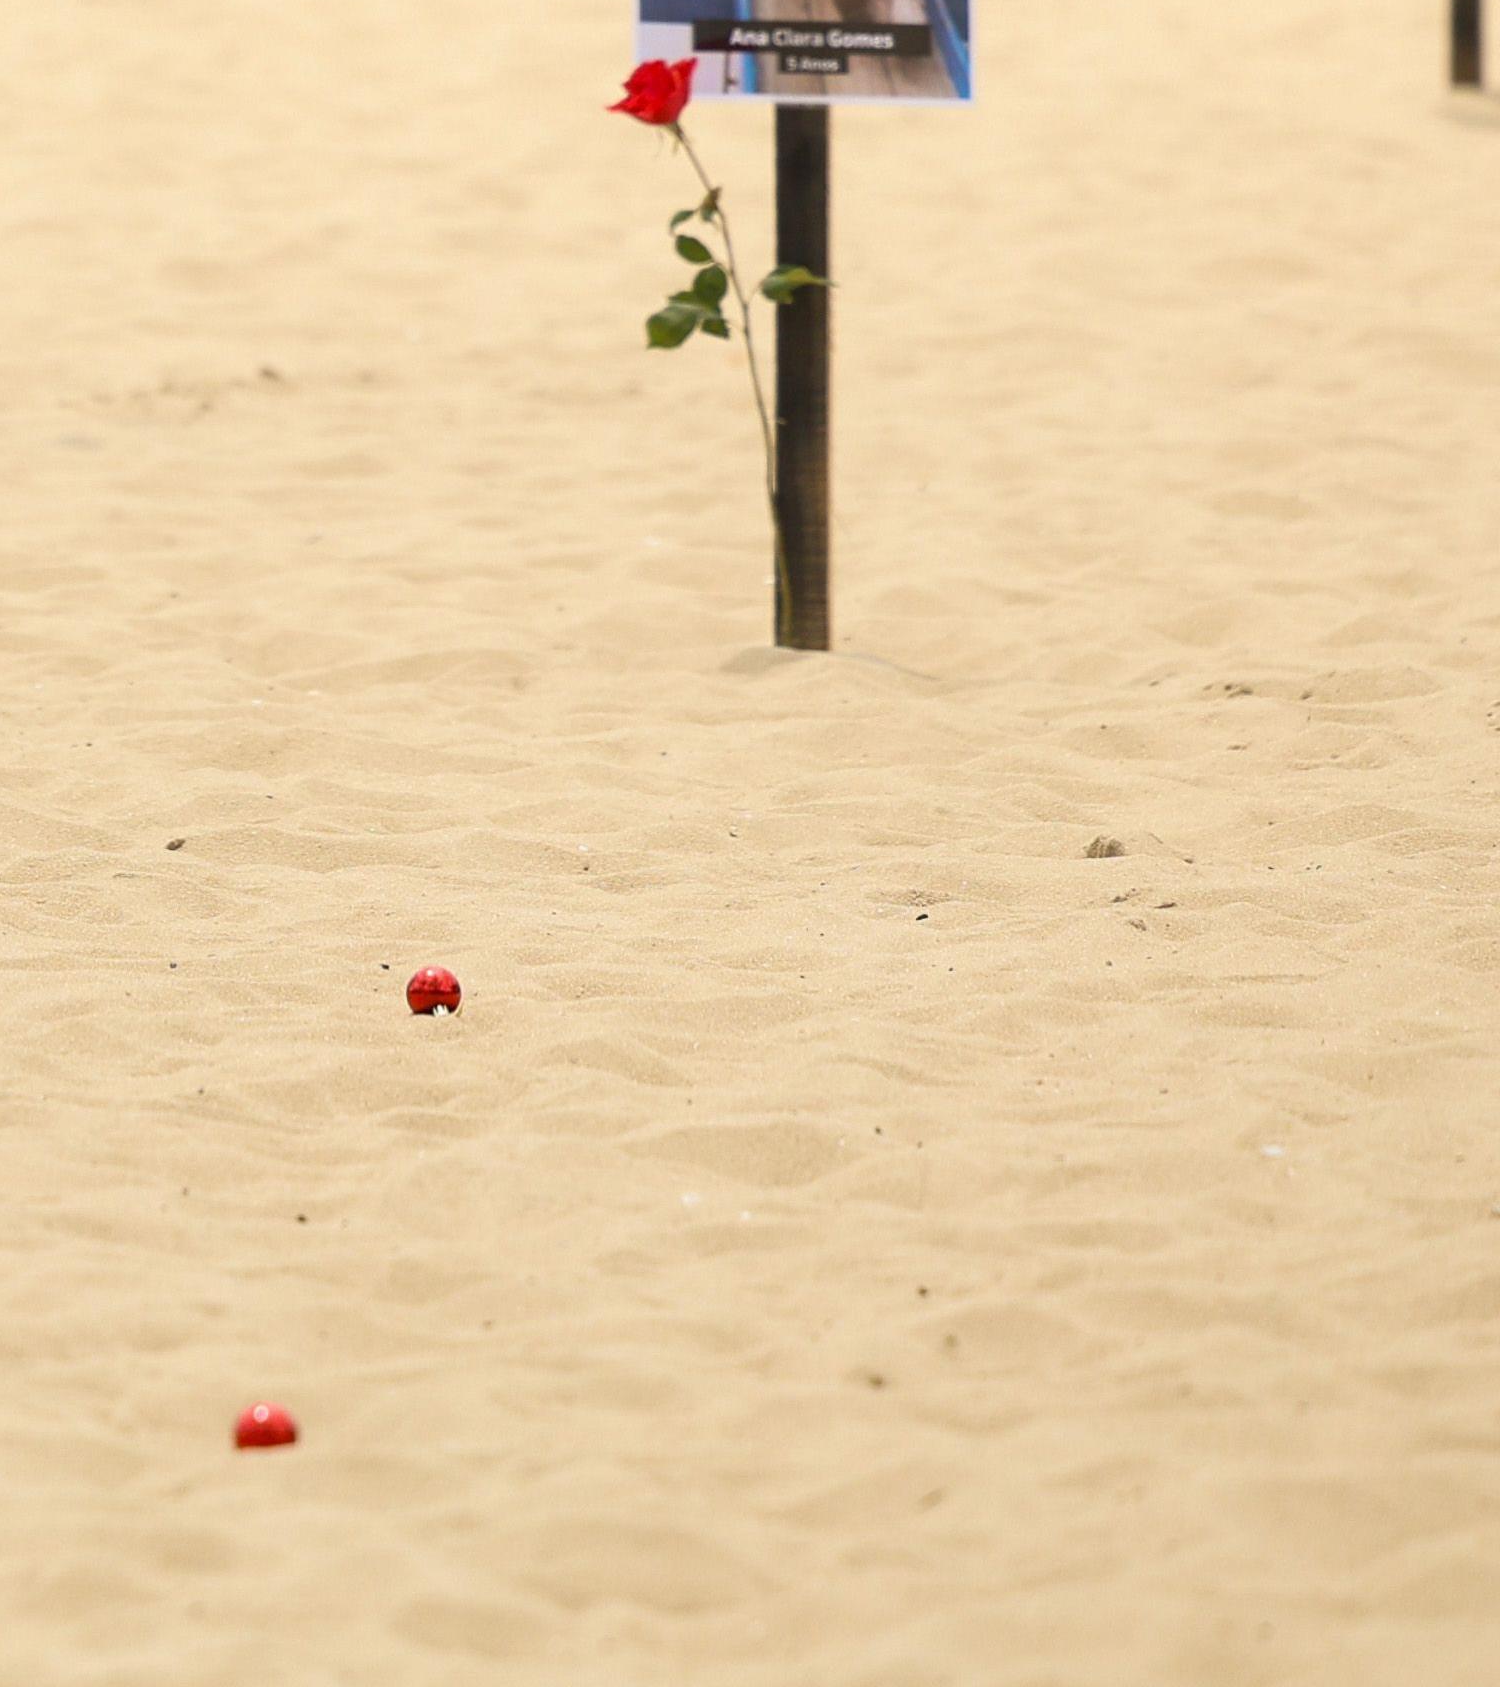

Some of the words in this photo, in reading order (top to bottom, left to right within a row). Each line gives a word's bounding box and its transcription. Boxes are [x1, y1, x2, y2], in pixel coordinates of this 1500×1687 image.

[730, 27, 769, 47] Ana
[772, 28, 824, 48] Clara
[827, 30, 894, 50] Gomes
